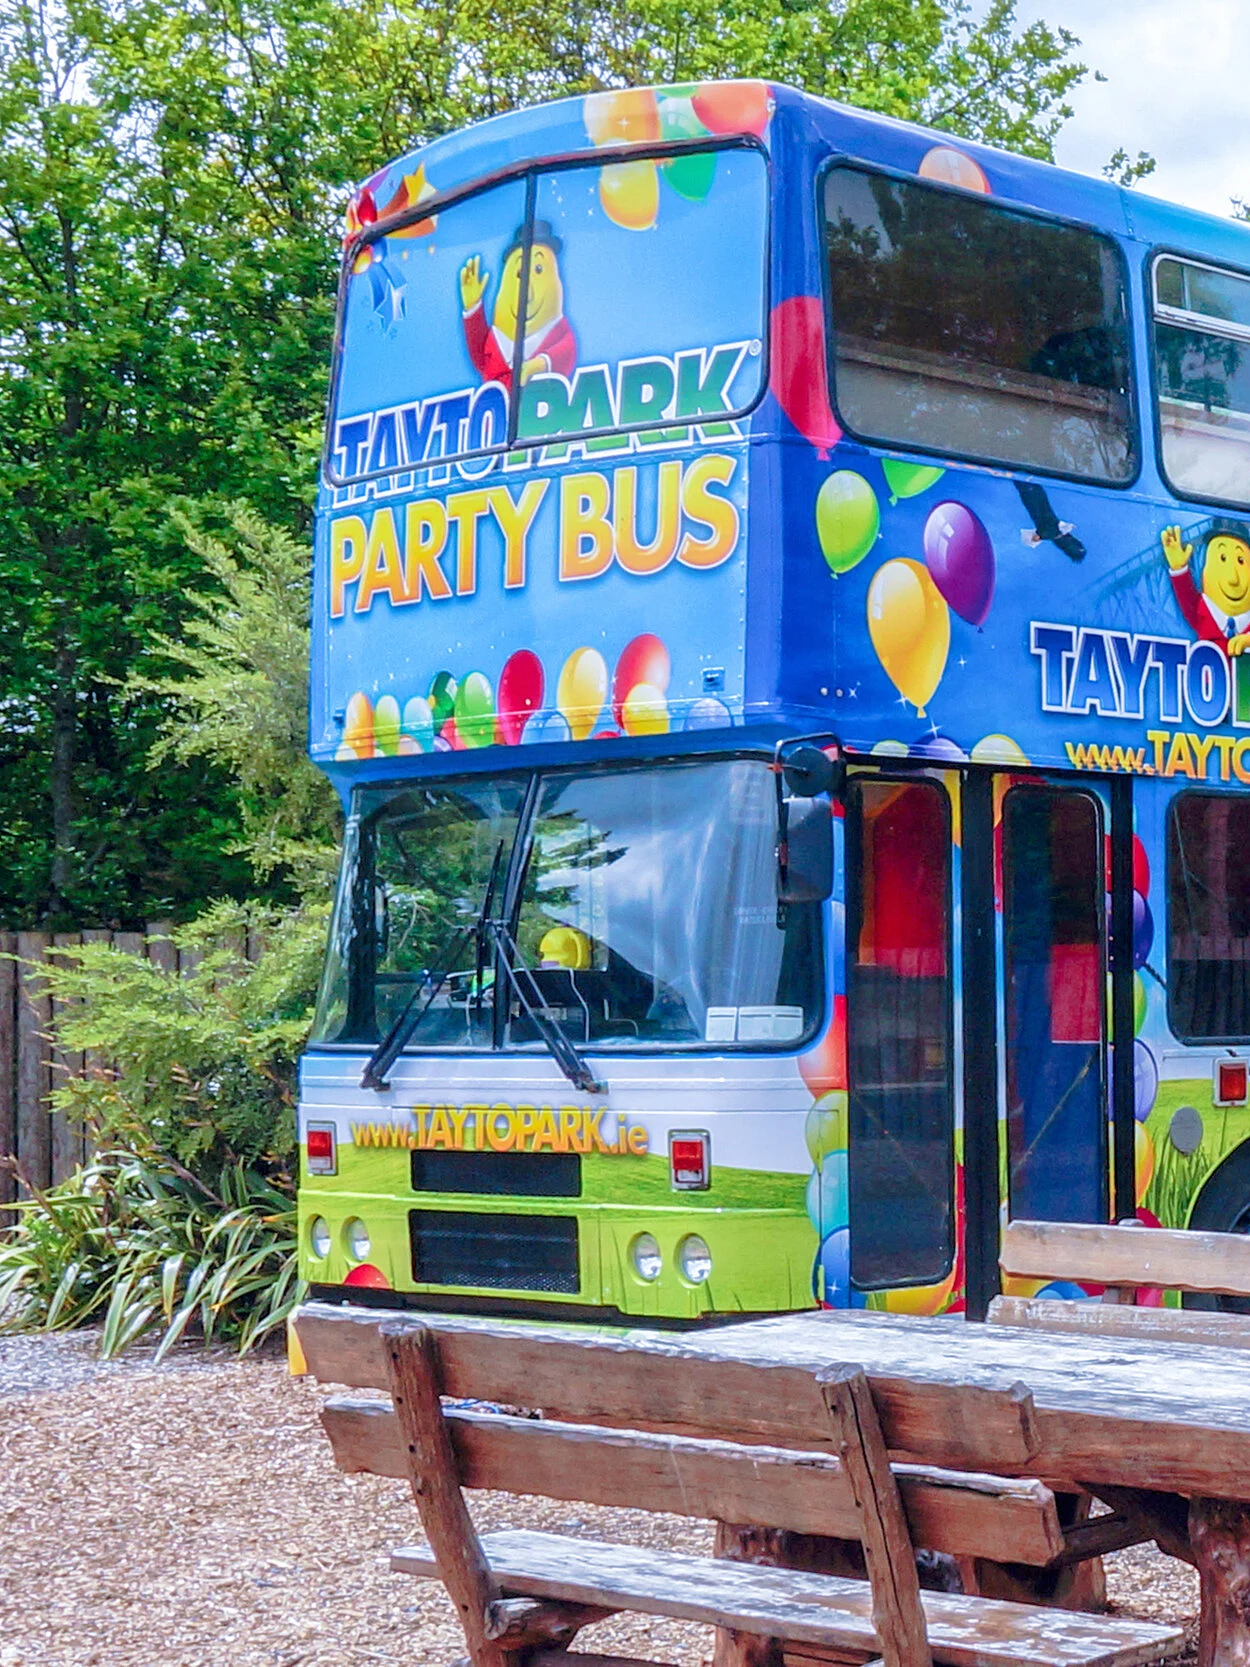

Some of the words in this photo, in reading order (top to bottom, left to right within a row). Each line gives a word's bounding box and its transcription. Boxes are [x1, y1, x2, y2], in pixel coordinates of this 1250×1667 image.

[332, 379, 510, 509] TAYTO
[502, 340, 752, 472] PARK
[329, 478, 551, 619] PARTY
[558, 453, 740, 583] BUS
[1030, 621, 1230, 727] TAYTO
[349, 1103, 649, 1156] www.TAYTOPARK.ie
